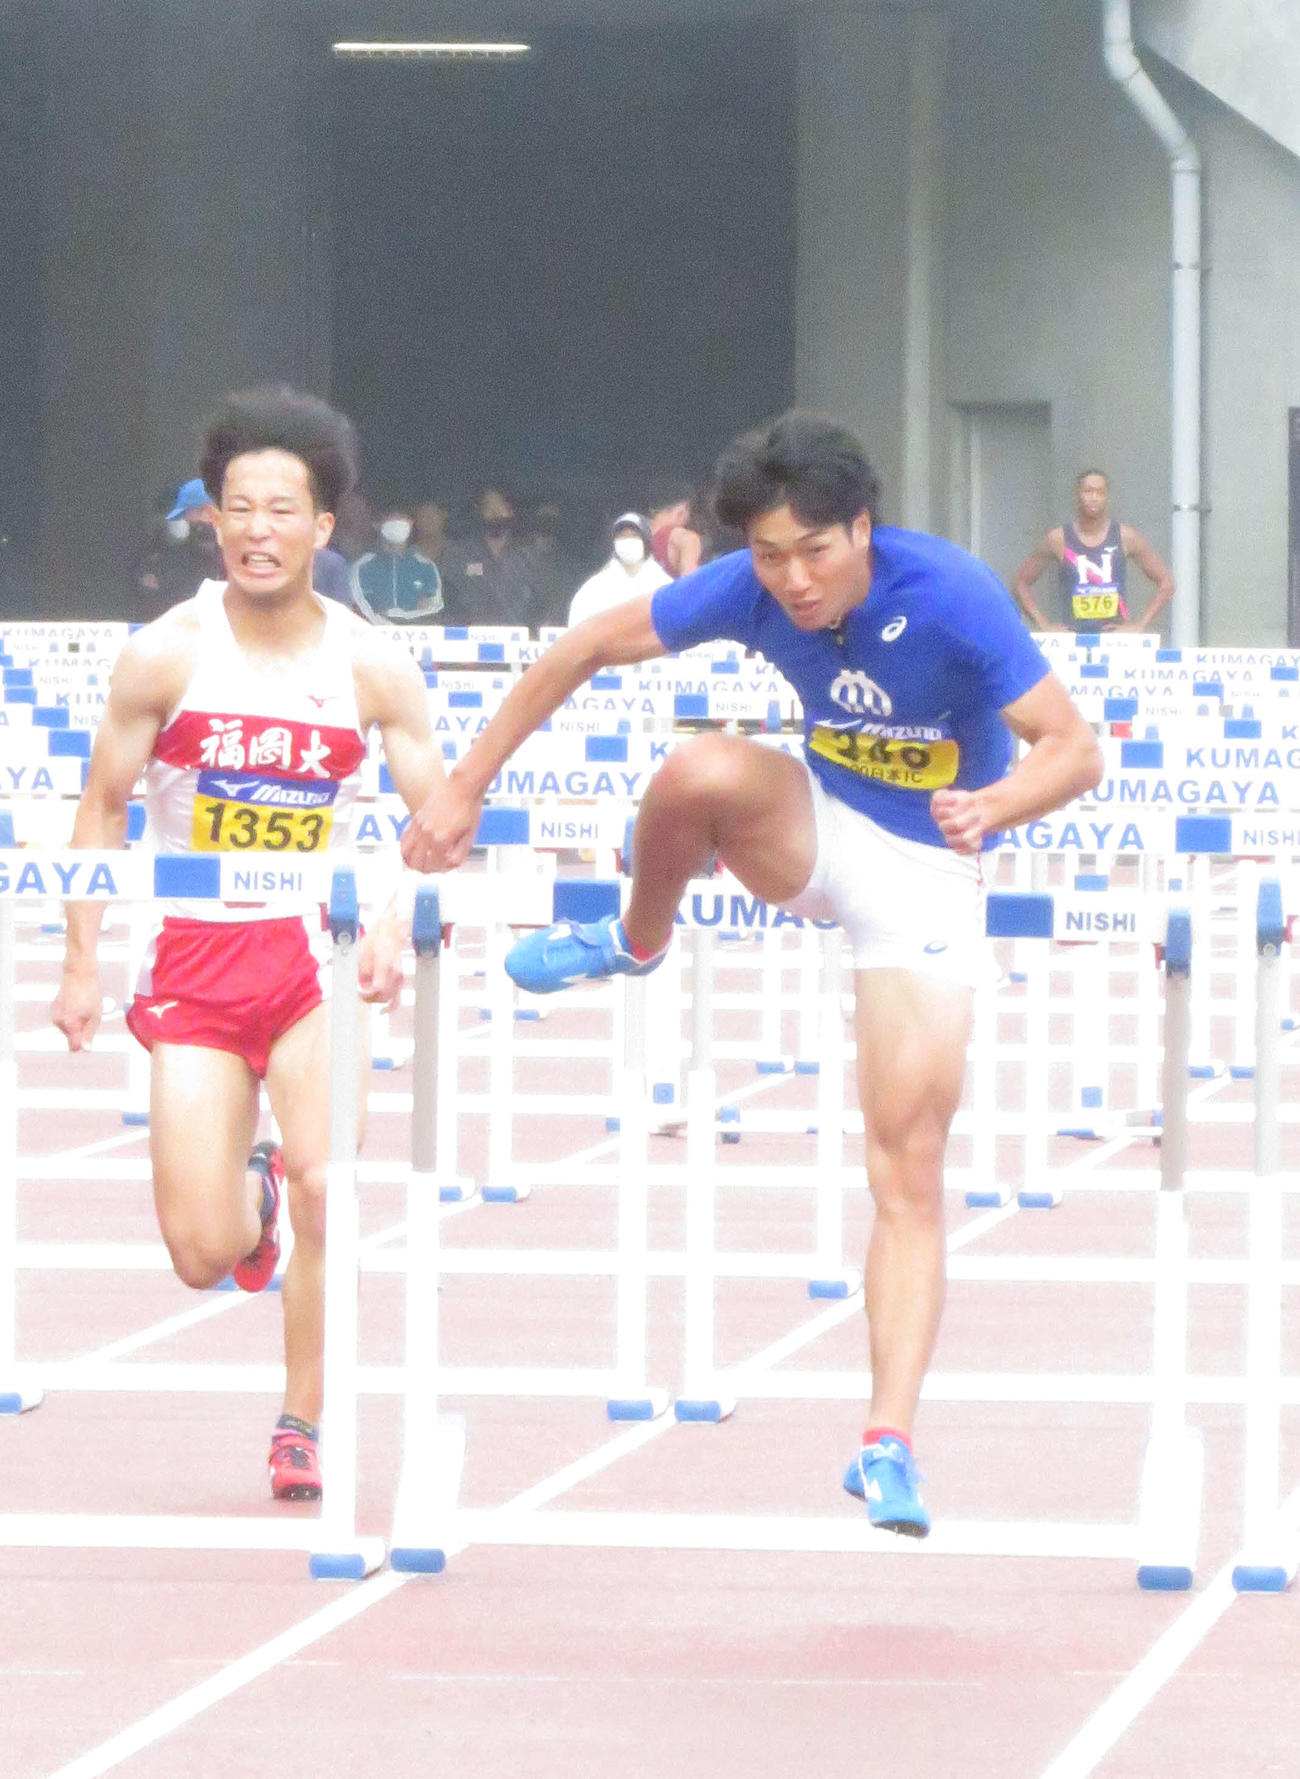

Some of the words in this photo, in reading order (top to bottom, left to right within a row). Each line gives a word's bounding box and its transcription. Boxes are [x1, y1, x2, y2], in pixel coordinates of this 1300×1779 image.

[1080, 595, 1113, 612] 576
[200, 718, 332, 779] 福岡大
[205, 802, 324, 853] 1353
[540, 822, 599, 839] NISHI
[233, 871, 303, 892] NISHI
[1066, 911, 1136, 932] NISHI
